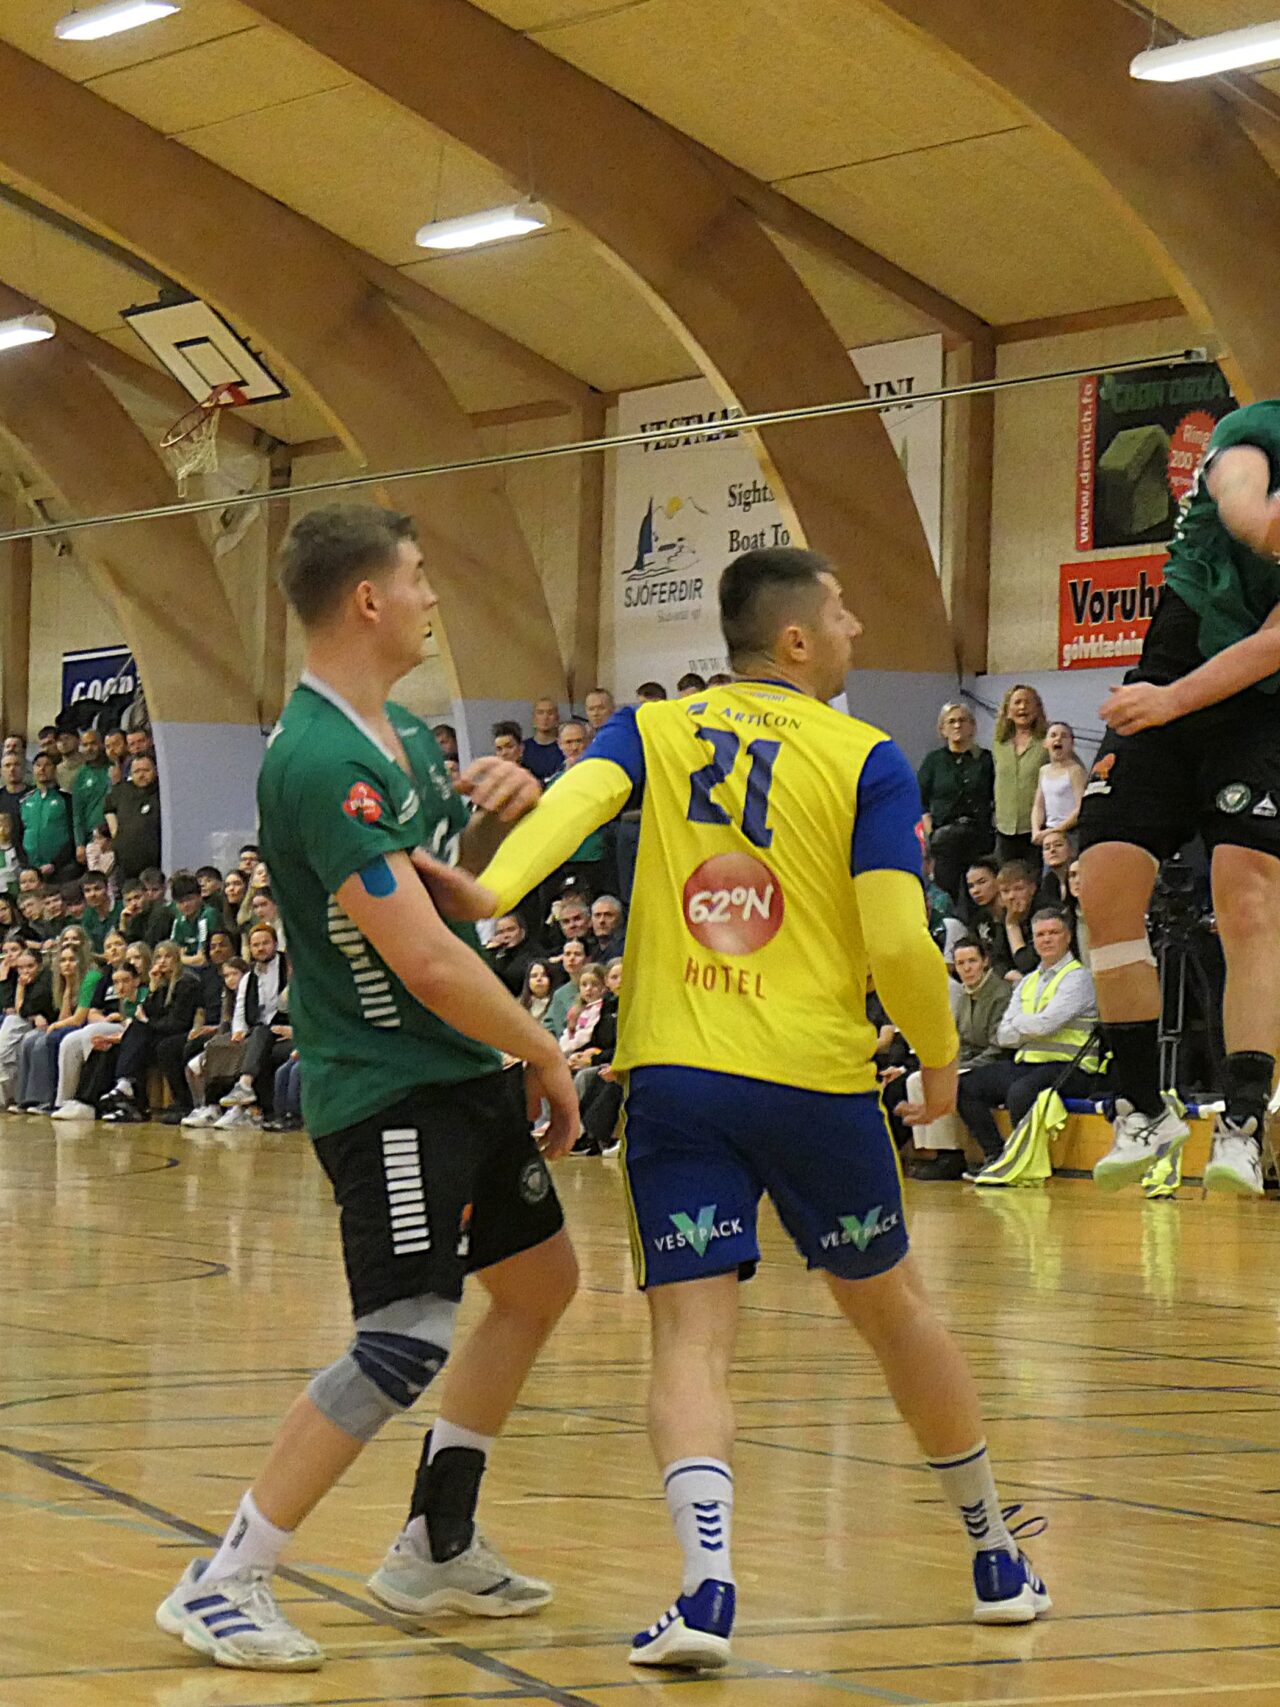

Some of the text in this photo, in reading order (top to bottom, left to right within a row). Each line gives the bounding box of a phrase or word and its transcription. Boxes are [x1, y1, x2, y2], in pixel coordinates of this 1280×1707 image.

[728, 529, 766, 553] Boat
[1068, 570, 1165, 627] Vøruh
[687, 725, 783, 850] 21
[684, 957, 767, 1001] HOTEL
[654, 1217, 744, 1252] VESTPACK
[820, 1212, 899, 1251] VESTPACK
